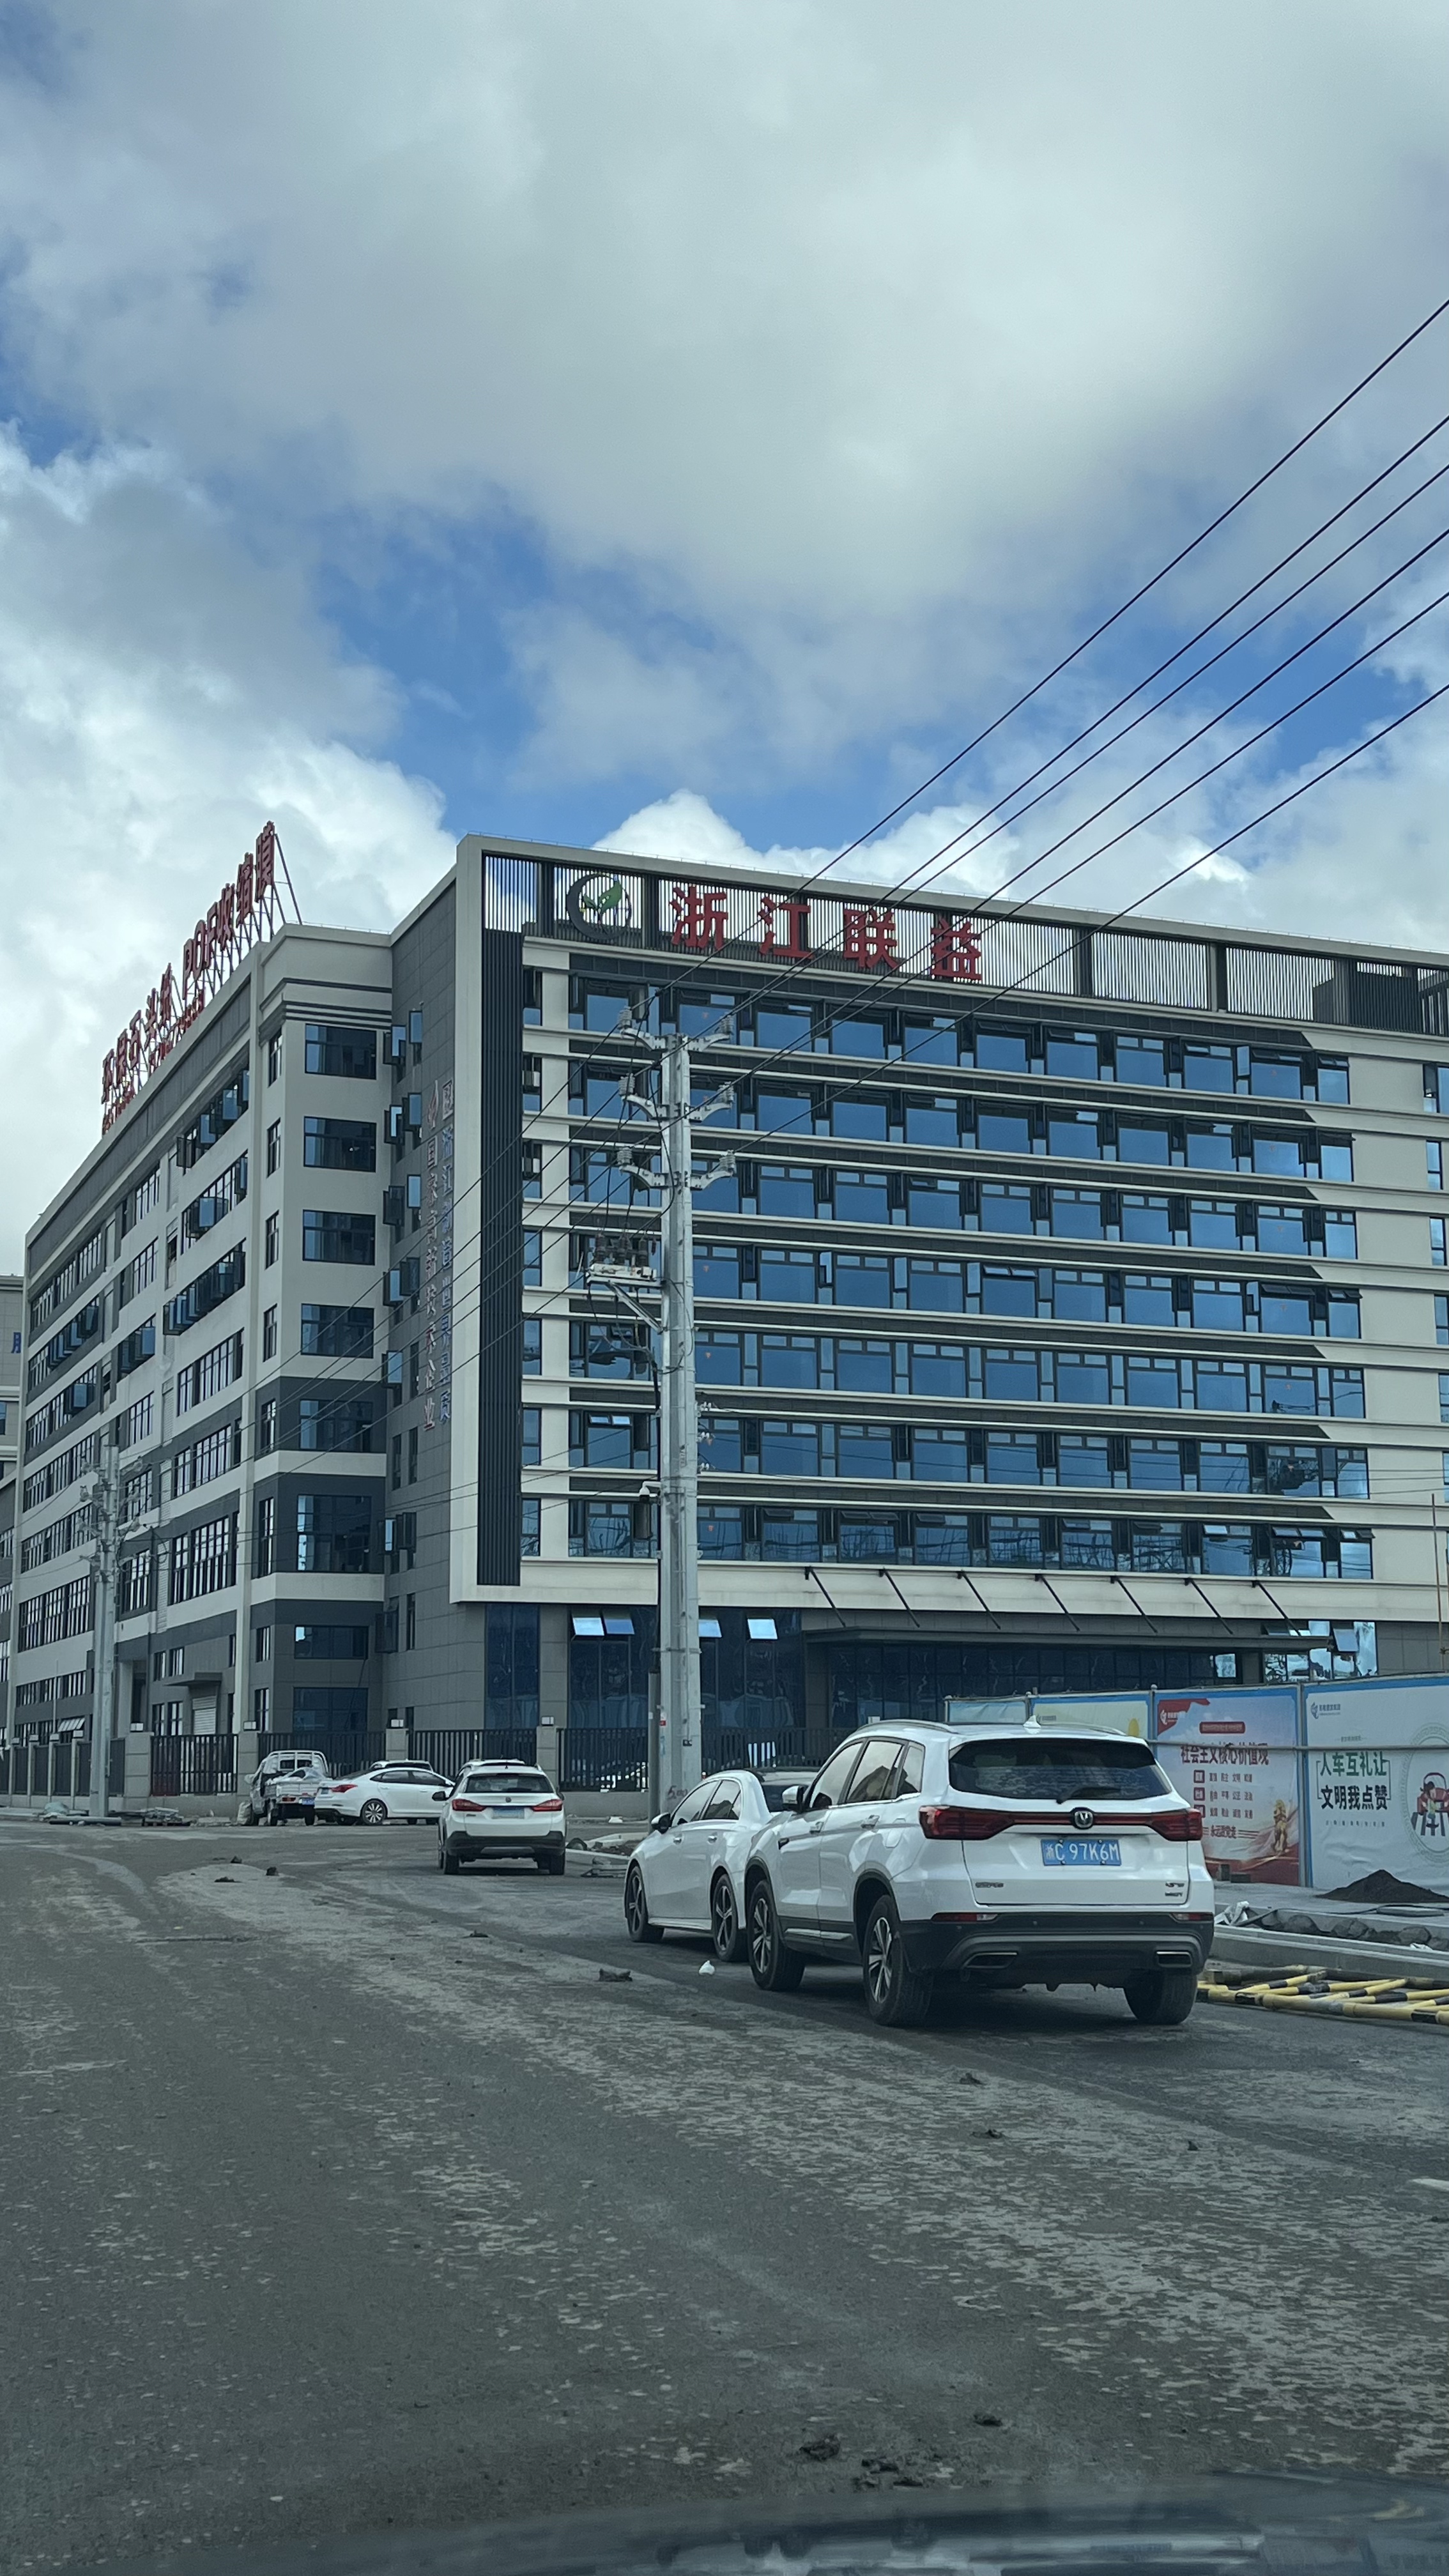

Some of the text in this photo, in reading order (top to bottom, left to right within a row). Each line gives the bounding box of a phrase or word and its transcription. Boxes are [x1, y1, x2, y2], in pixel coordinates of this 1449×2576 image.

[669, 884, 981, 981] 浙江联益
[424, 1135, 438, 1431] 国家高新技术企业
[1181, 1742, 1269, 1765] 社会主义核心价值观
[1321, 1751, 1386, 1777] 人车互礼让
[1321, 1784, 1388, 1810] 文明我点赞
